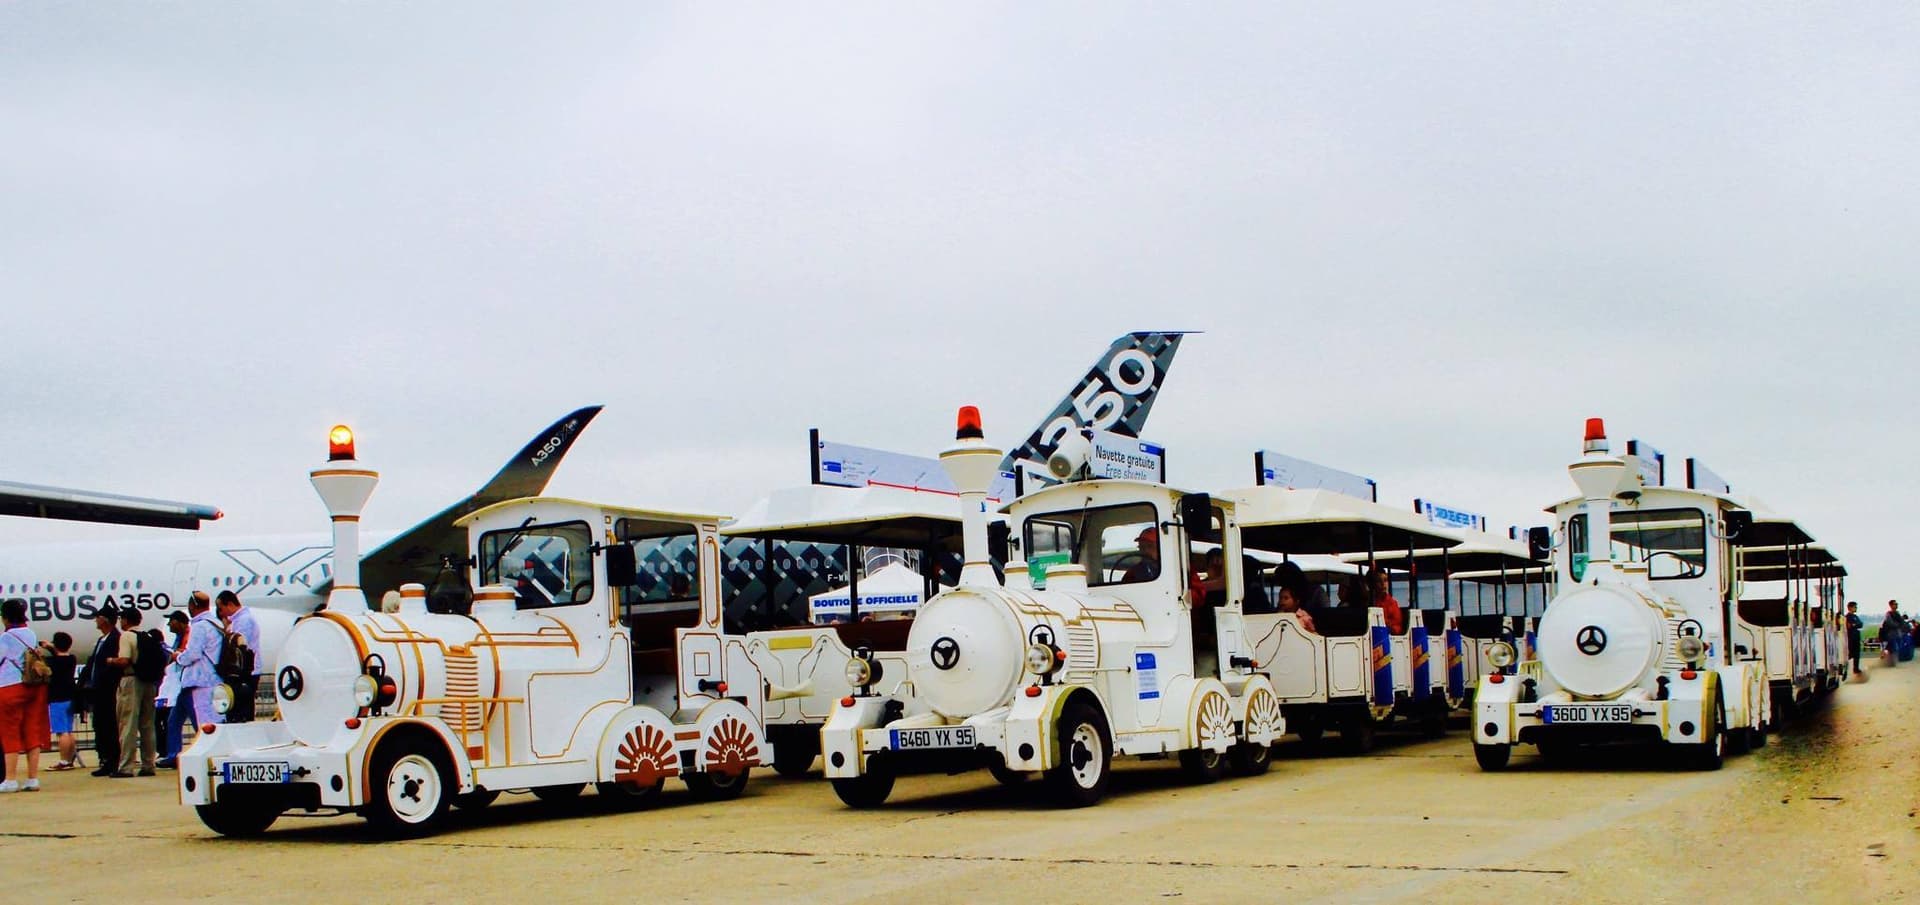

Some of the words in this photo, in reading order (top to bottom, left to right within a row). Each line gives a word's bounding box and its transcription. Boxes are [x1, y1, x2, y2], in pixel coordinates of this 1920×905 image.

[530, 436, 562, 467] A350
[1096, 445, 1125, 463] Navette
[1127, 455, 1155, 469] gratuite
[1105, 463, 1122, 479] Free
[102, 593, 170, 612] A350
[814, 597, 863, 608] BOUTIQE
[865, 595, 918, 605] OFFICIELLE
[1552, 707, 1587, 721] 3600
[1592, 707, 1609, 721] YX
[1611, 707, 1629, 721] 95
[900, 731, 930, 747] 6460
[936, 730, 951, 746] YX
[956, 729, 972, 745] 95
